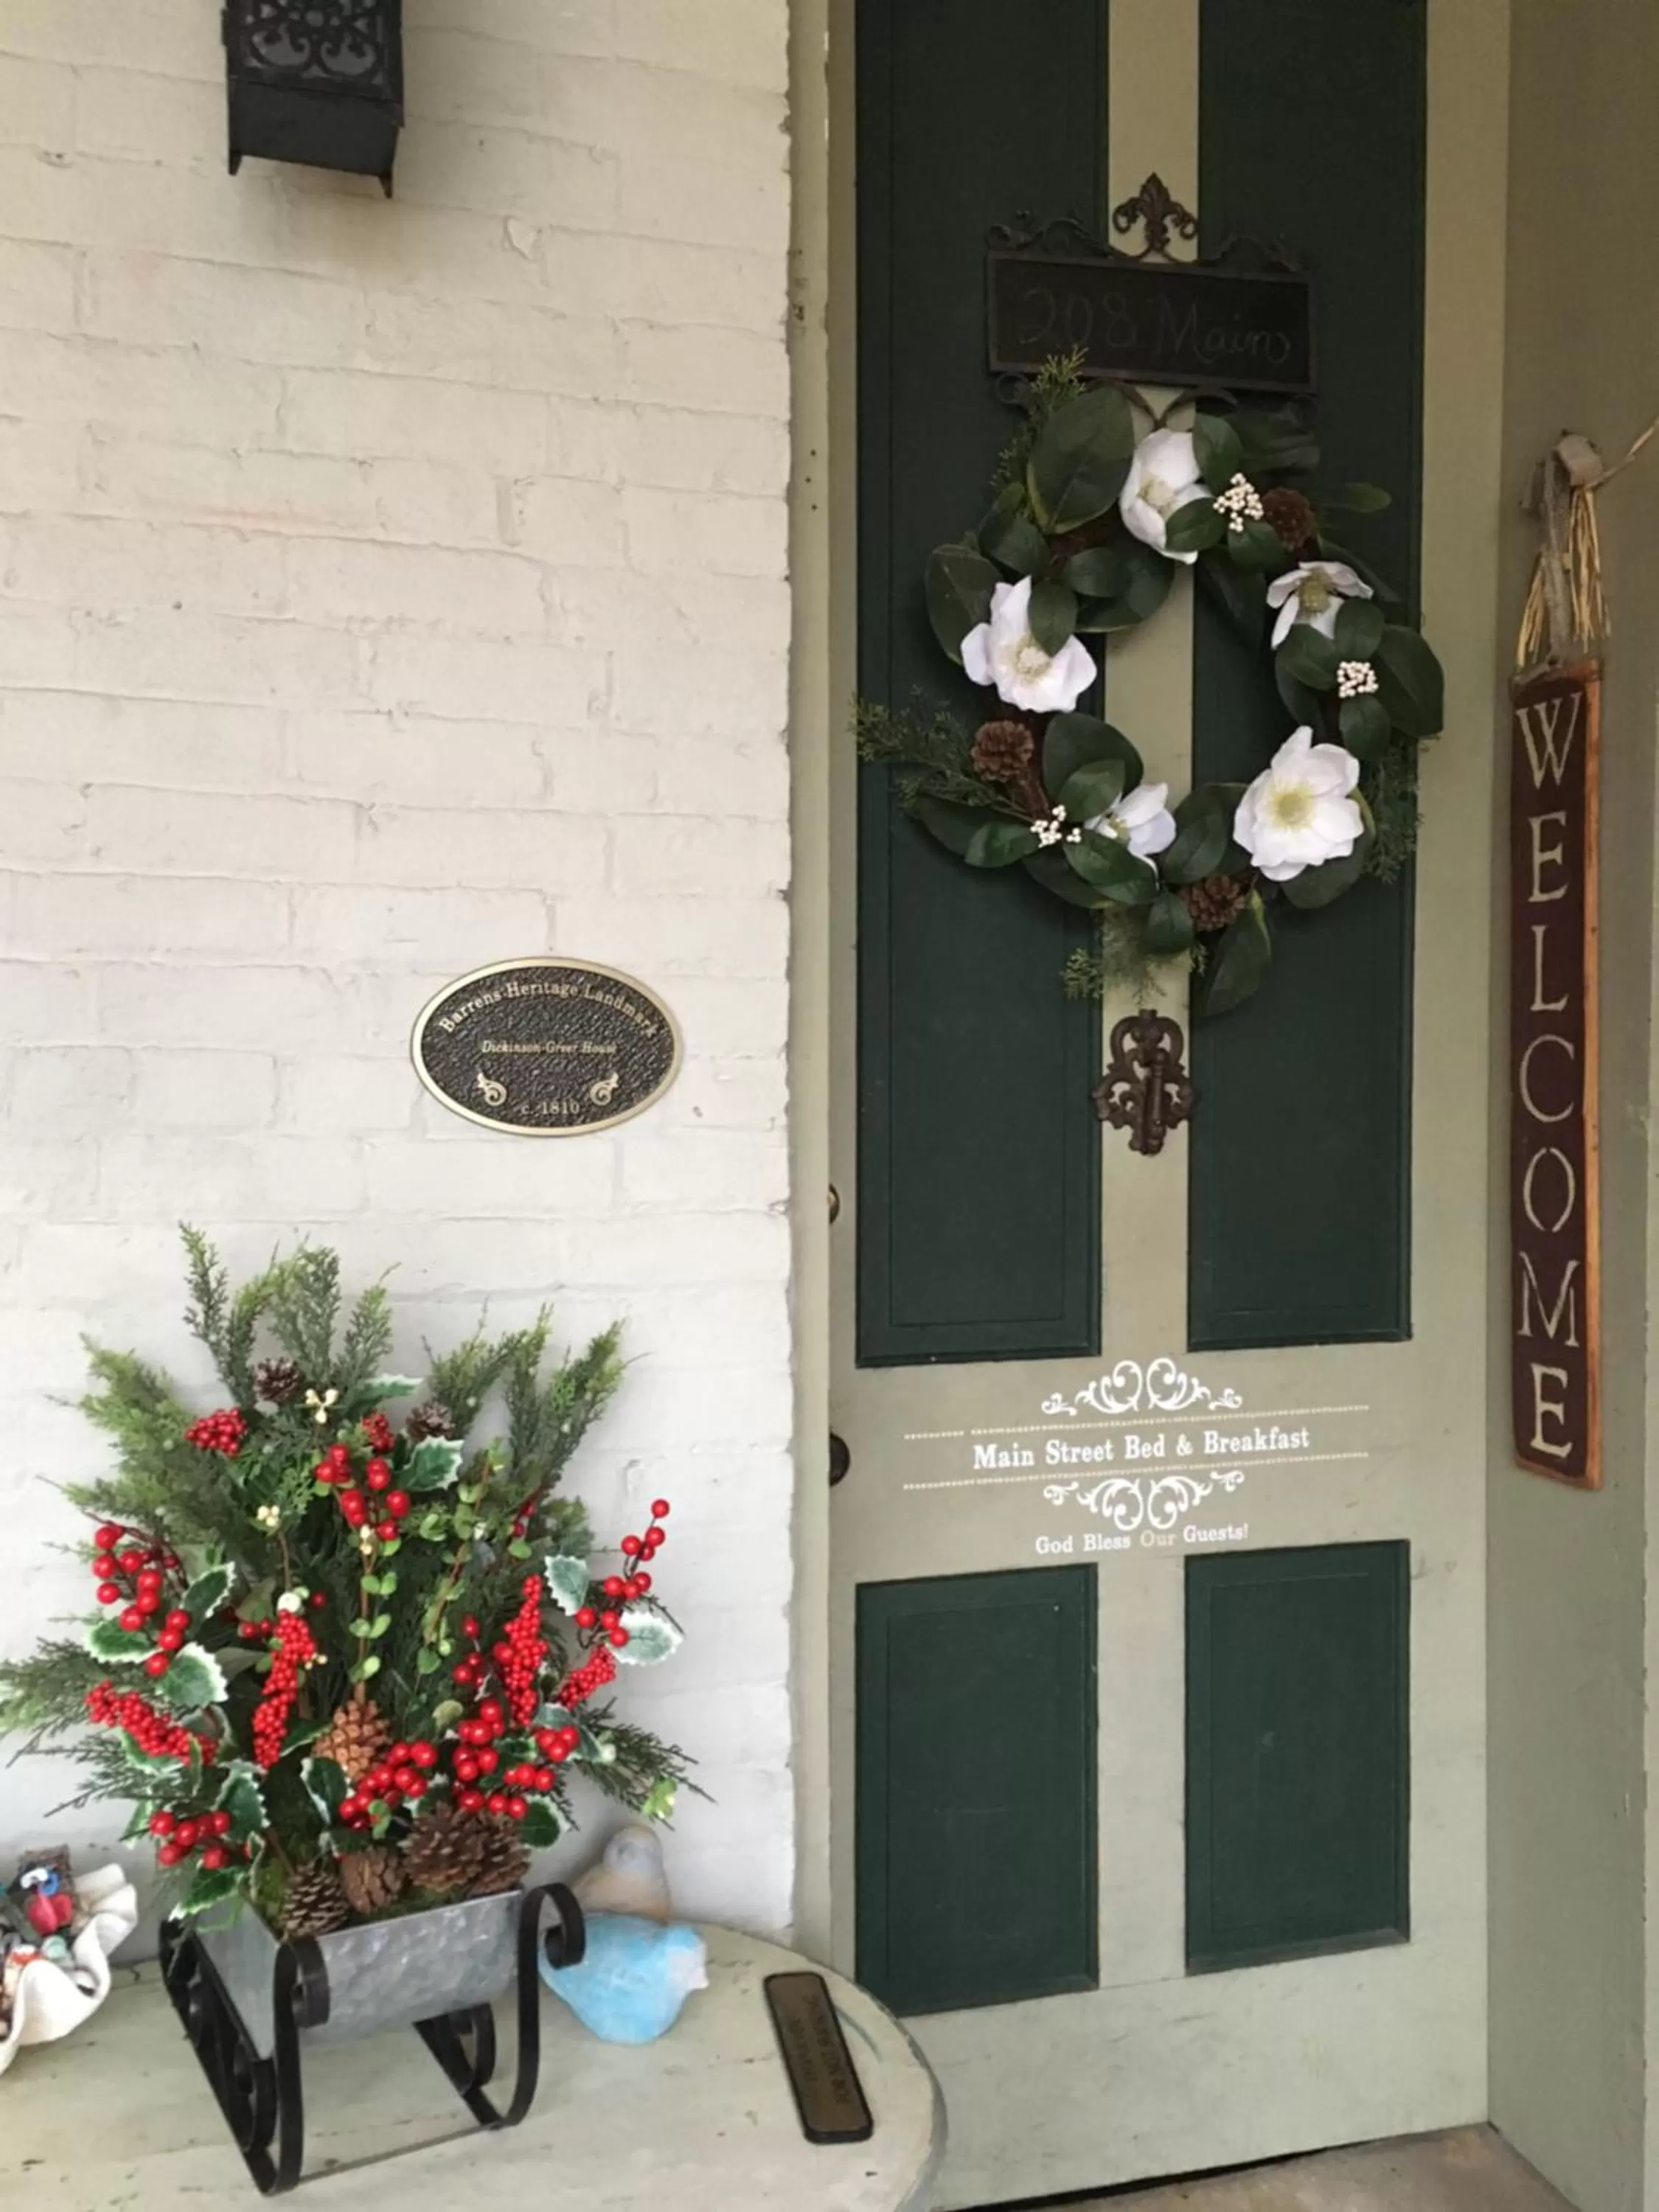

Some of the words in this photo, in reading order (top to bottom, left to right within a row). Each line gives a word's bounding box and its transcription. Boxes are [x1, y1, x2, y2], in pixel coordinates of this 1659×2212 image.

[439, 992, 502, 1032] Barrens
[506, 981, 578, 998] Heritage
[584, 986, 658, 1037] Landmark
[1516, 692, 1582, 1458] WELCOME
[541, 1102, 580, 1115] 1810
[973, 1444, 1035, 1470] Main
[1046, 1439, 1113, 1464] Street
[1124, 1434, 1166, 1459] Bed
[1176, 1436, 1193, 1456] &
[1203, 1427, 1310, 1455] Breakfast
[1035, 1536, 1074, 1555] God
[1083, 1533, 1130, 1551] Bless
[1140, 1529, 1177, 1547] Our
[1183, 1523, 1249, 1544] Guests!
